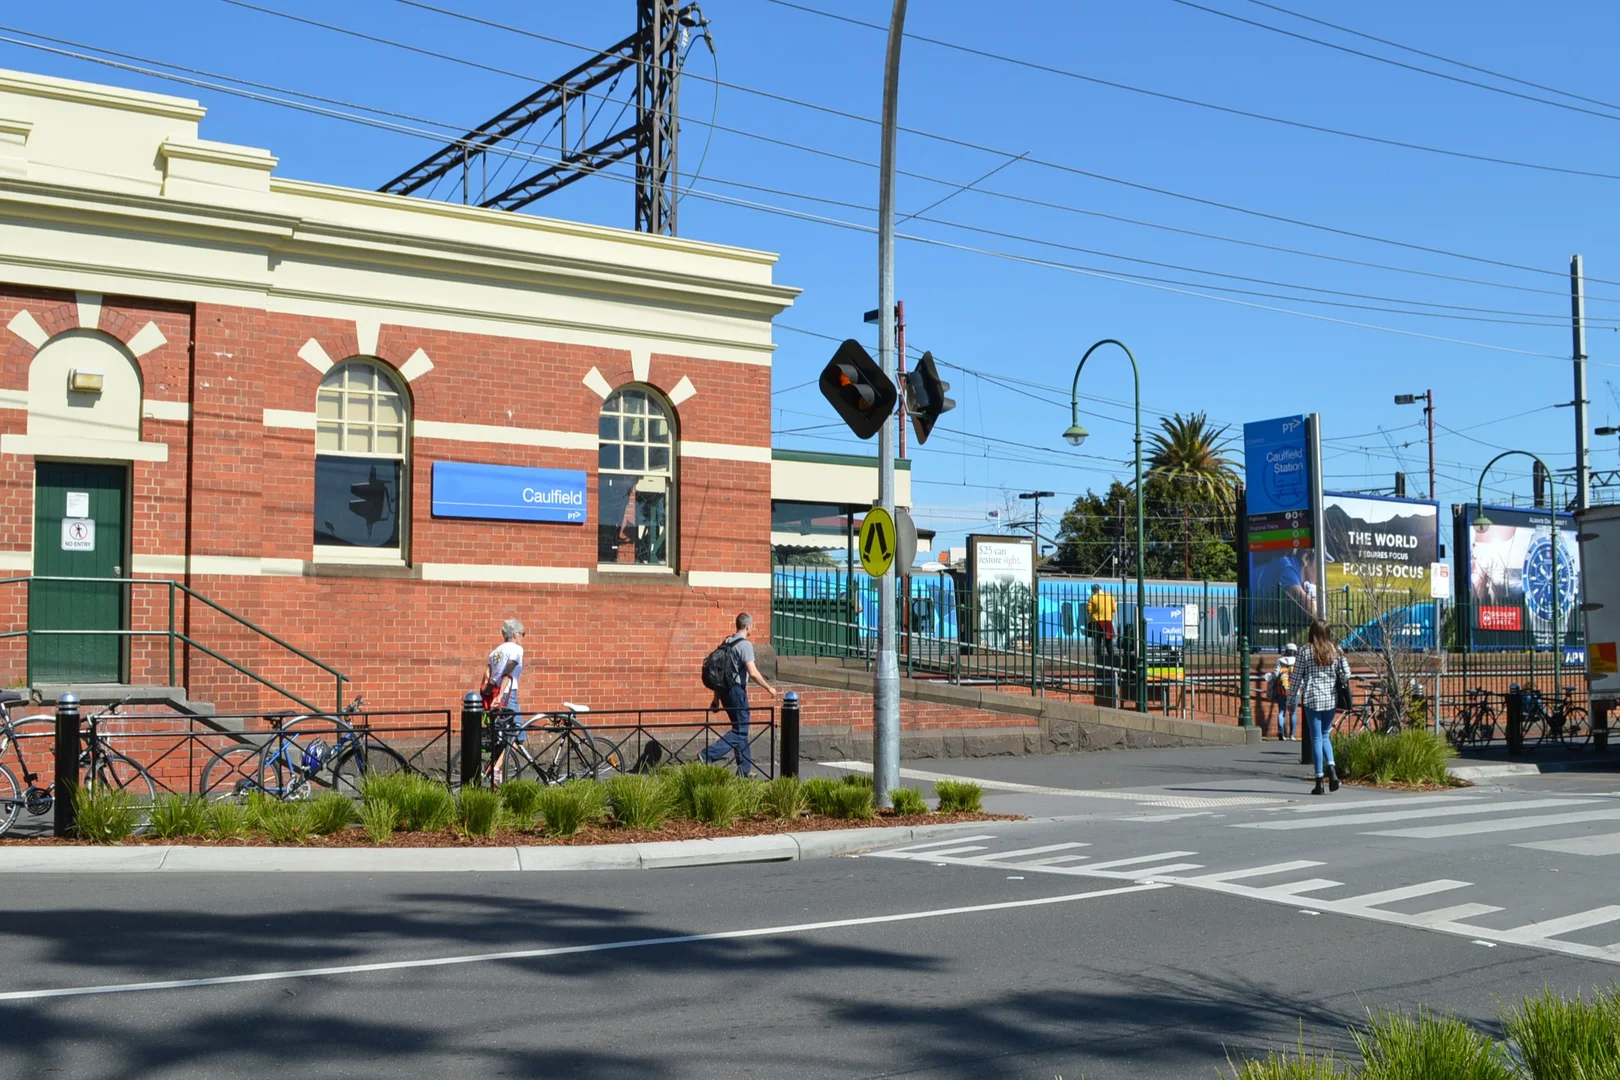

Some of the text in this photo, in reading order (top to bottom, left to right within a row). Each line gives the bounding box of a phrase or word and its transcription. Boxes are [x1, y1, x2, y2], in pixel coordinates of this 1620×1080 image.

[1266, 448, 1303, 462] Caulfield
[1273, 461, 1303, 473] Station
[522, 487, 582, 505] Caulfield
[1348, 531, 1418, 548] THE WORLD
[979, 546, 992, 555] $25
[1389, 552, 1408, 560] FOCUS
[979, 556, 1002, 564] restore
[1343, 562, 1383, 577] FOCUS
[1385, 564, 1424, 579] FOCUS
